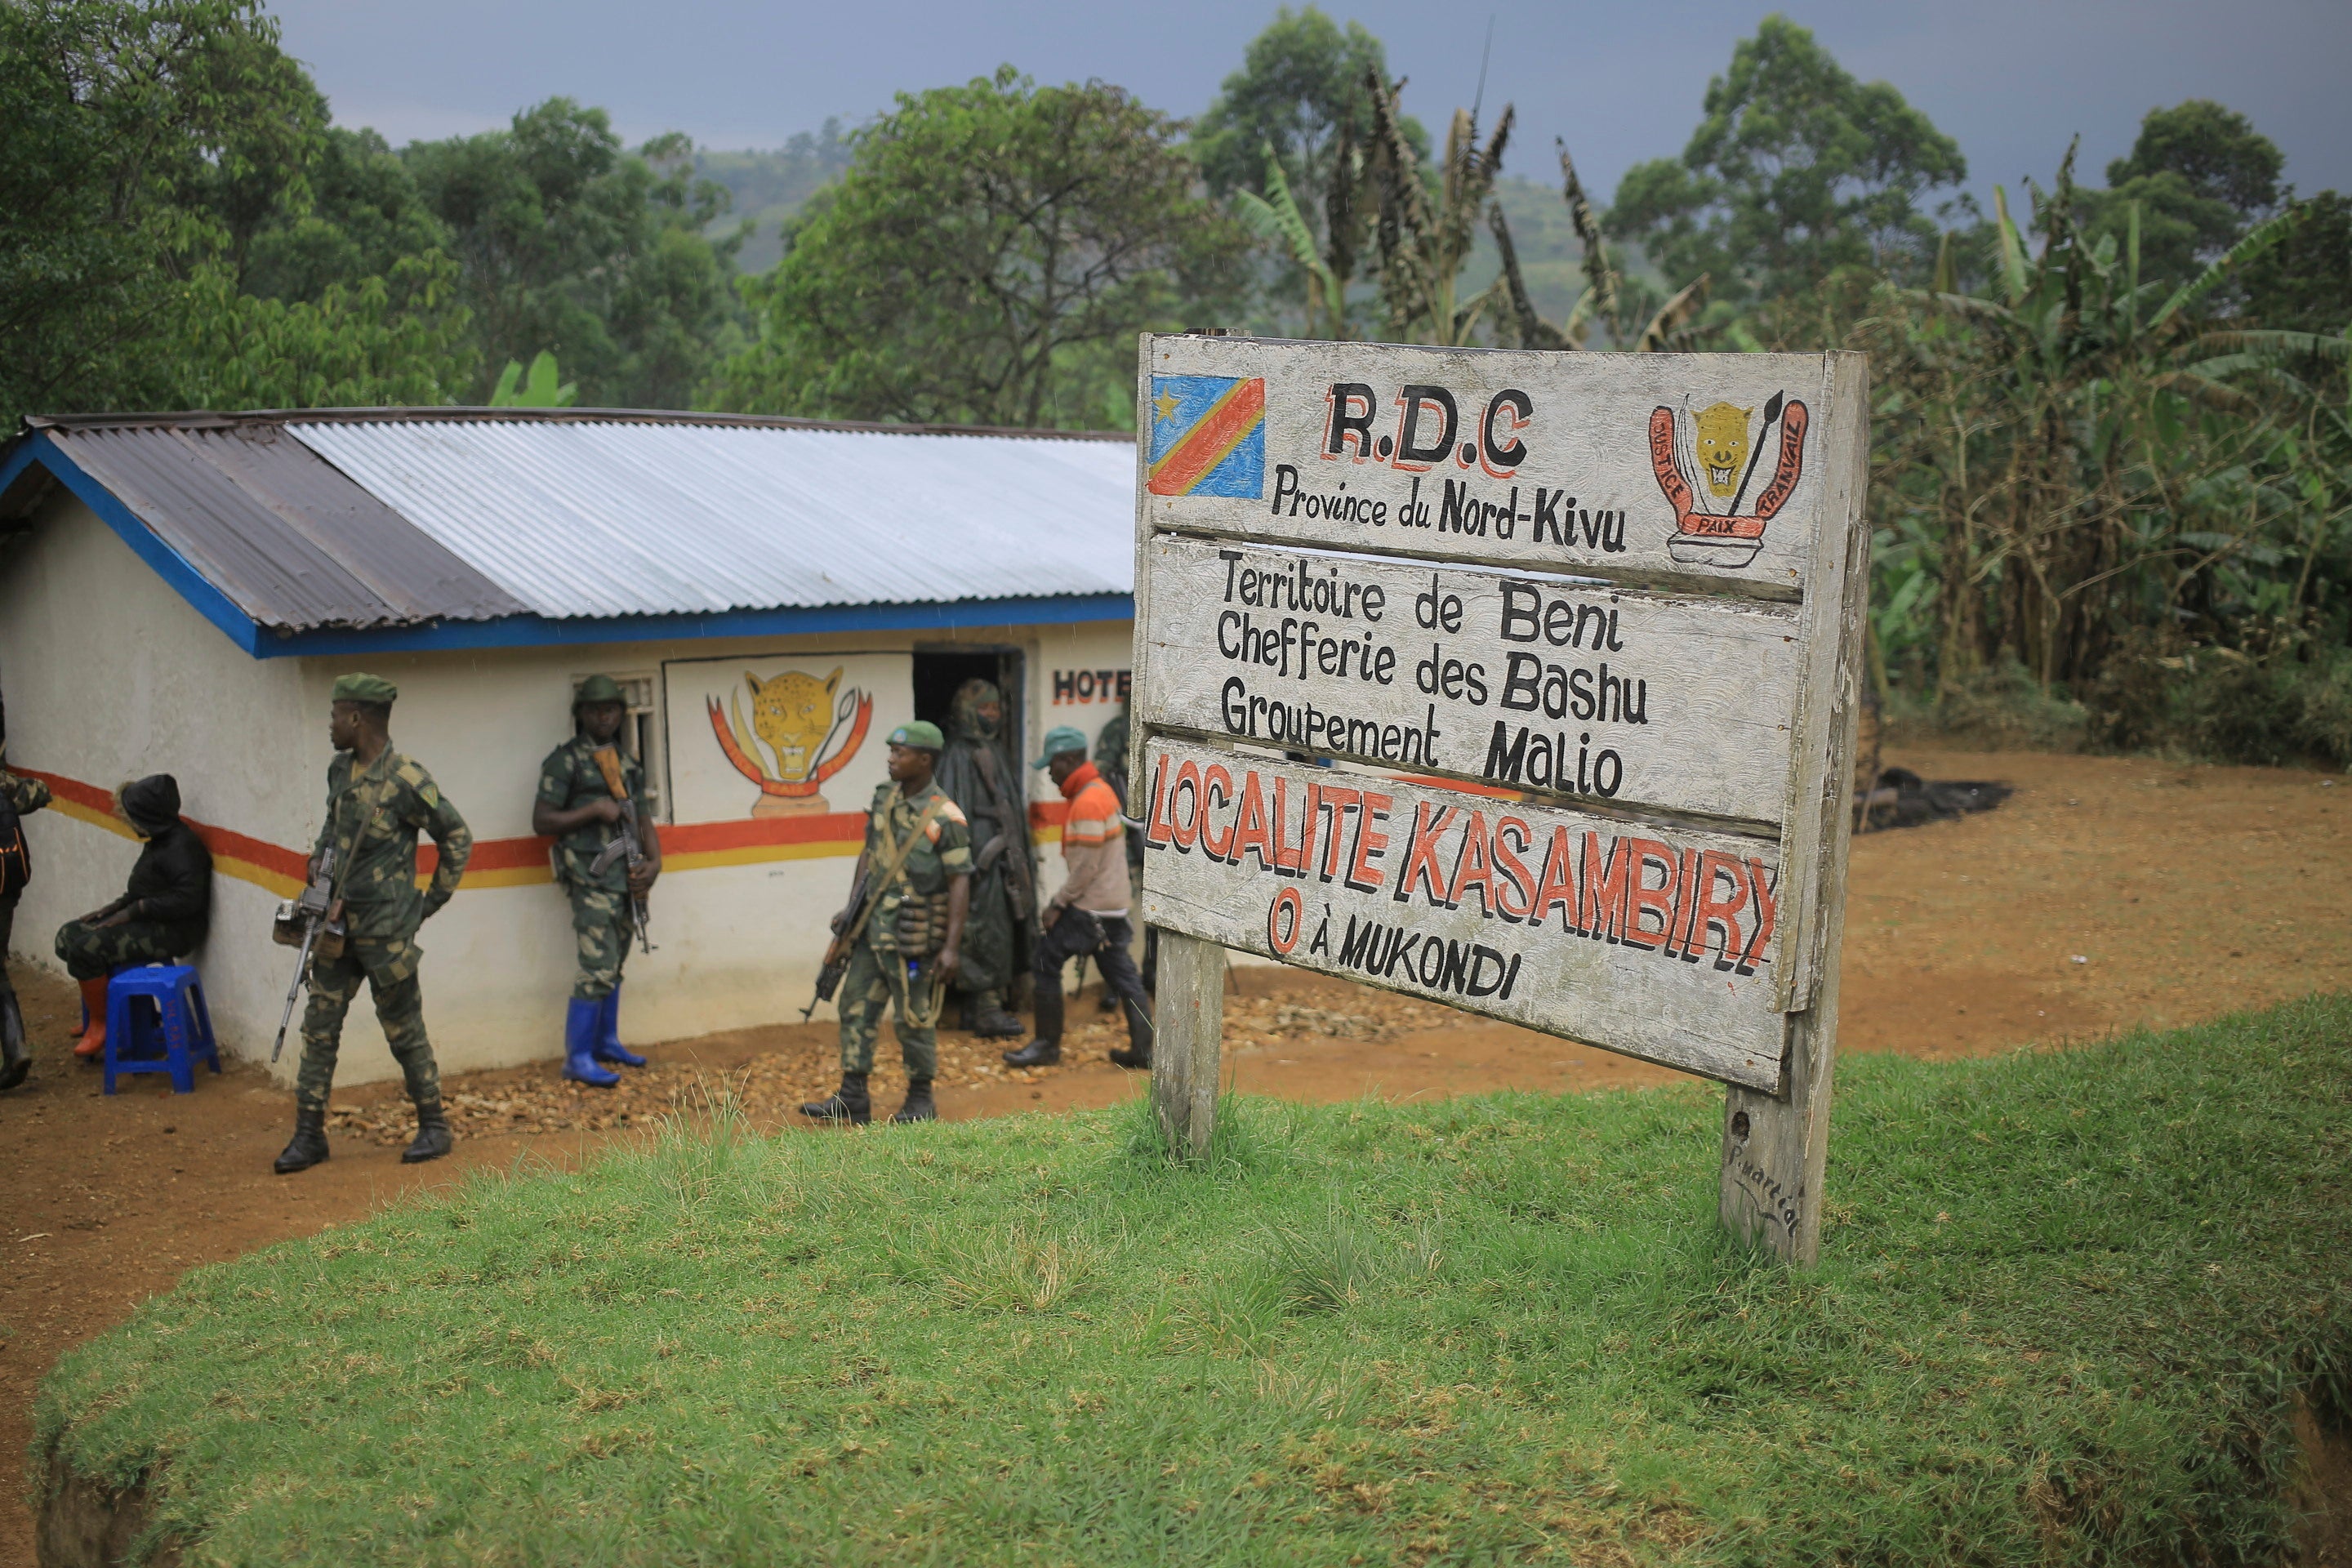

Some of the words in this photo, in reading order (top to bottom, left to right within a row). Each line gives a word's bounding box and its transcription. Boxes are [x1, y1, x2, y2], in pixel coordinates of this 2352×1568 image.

[1321, 382, 1533, 479] R.D.C
[1271, 464, 1388, 525] Province
[1398, 477, 1432, 527] du
[1439, 485, 1627, 553] Nord-Kivu
[1696, 517, 1738, 535] PAIX
[1219, 550, 1386, 622] Territoire
[1415, 572, 1463, 635] de
[1499, 581, 1624, 653] Beni
[1218, 610, 1396, 685] Chefferie
[1417, 642, 1489, 706] des
[1501, 652, 1649, 725] Bashu
[1221, 676, 1441, 768] Groupement
[1145, 753, 1393, 894] LOCALITE
[1311, 902, 1330, 957] À
[1338, 914, 1522, 1001] MUKONDI
